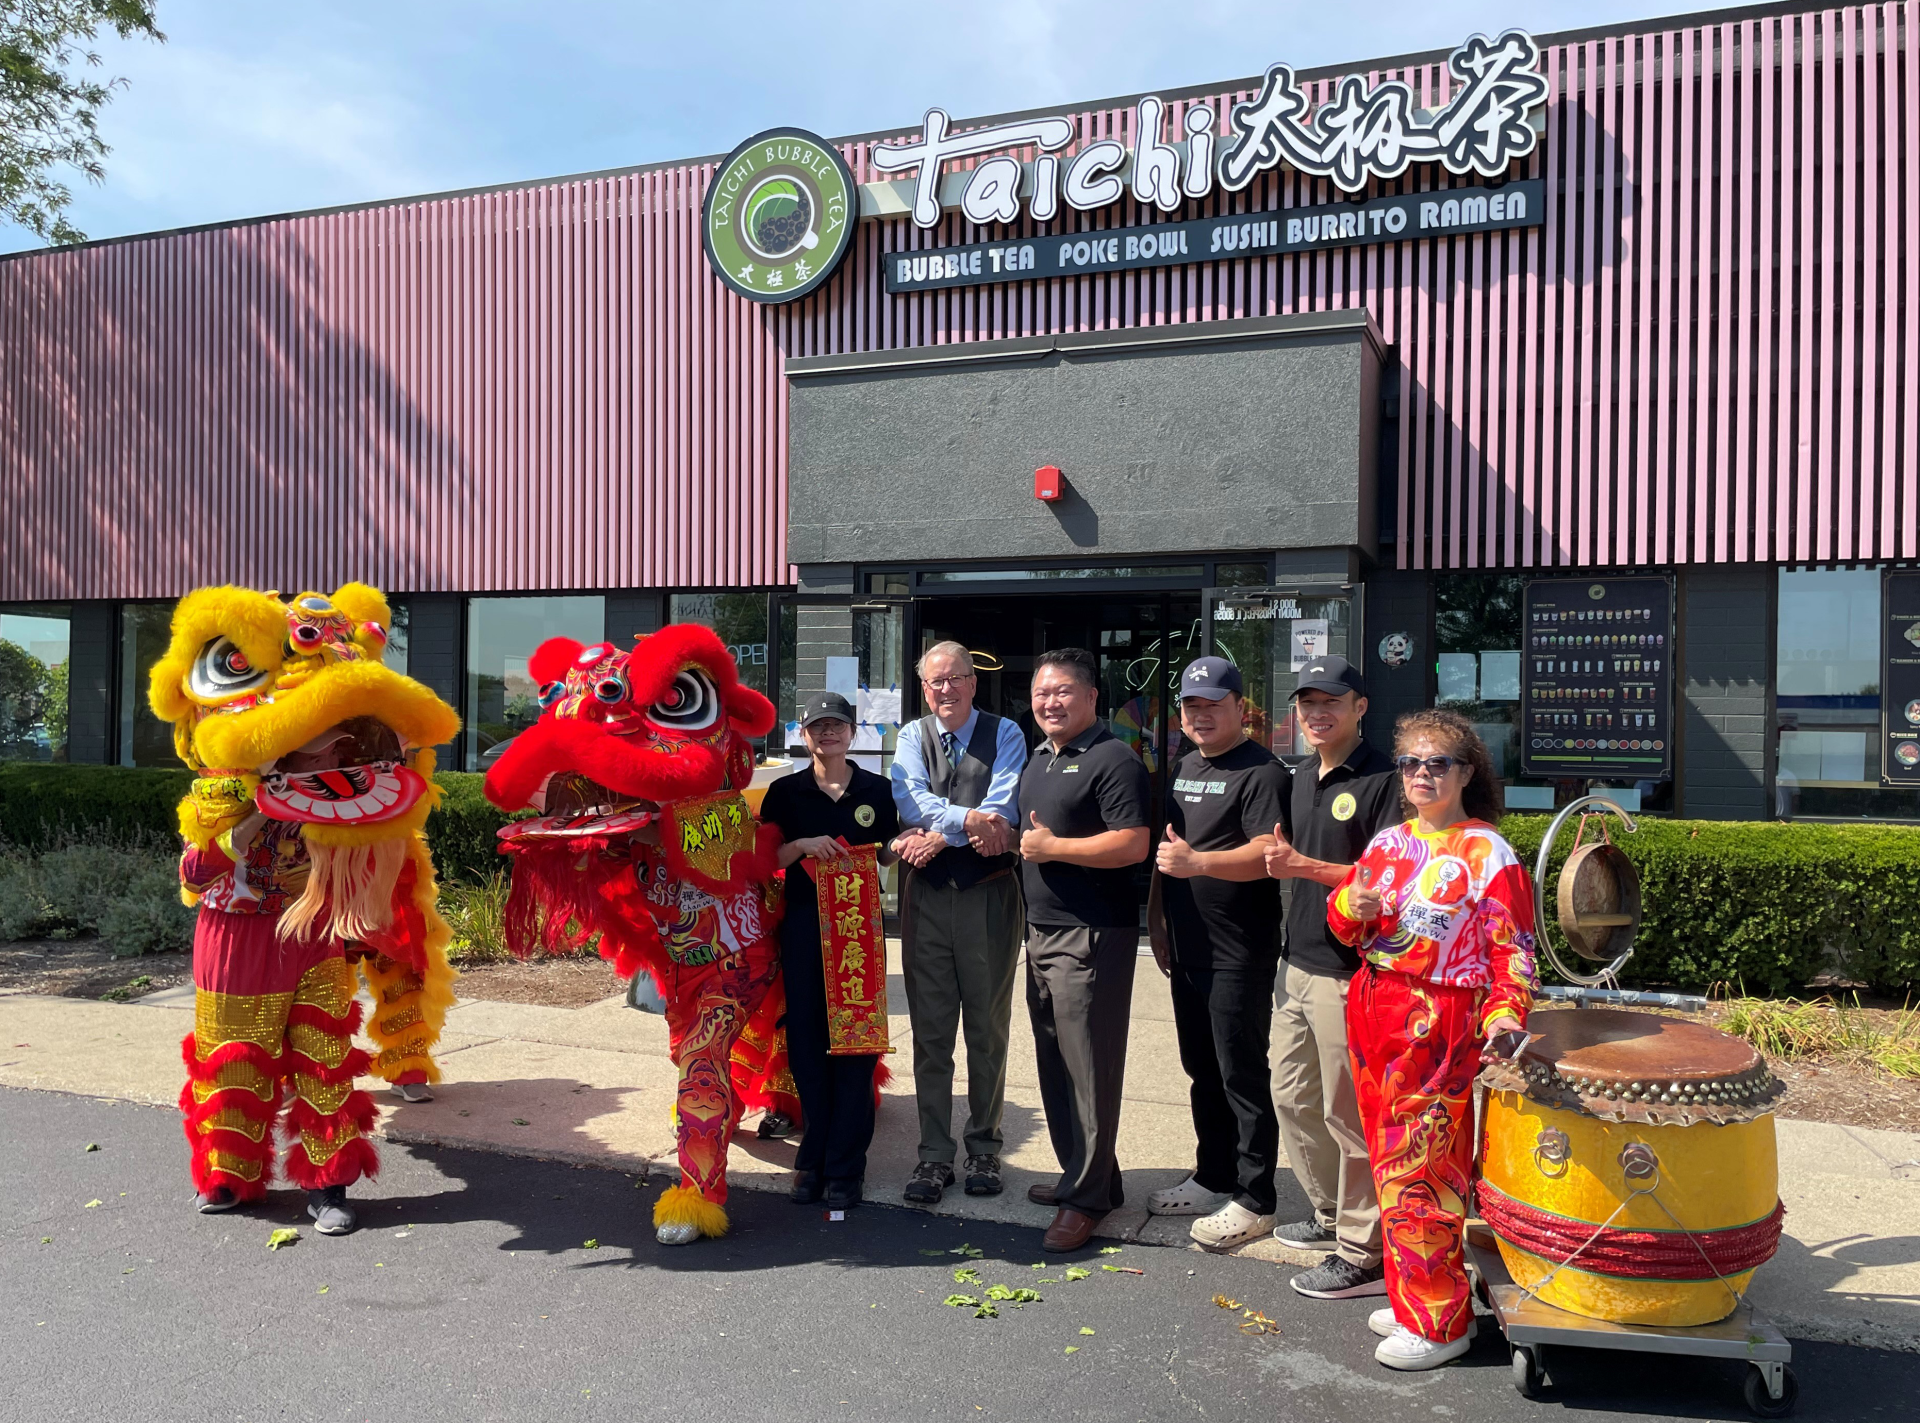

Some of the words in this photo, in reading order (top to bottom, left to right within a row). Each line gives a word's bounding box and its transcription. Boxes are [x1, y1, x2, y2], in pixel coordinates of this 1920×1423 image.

[715, 158, 755, 230] TAICHI
[766, 145, 831, 181] BUBBLE
[826, 191, 844, 234] TEA
[871, 96, 1215, 229] Taichi
[896, 248, 982, 284] BUBBLE
[988, 244, 1035, 273] TEA
[1058, 238, 1119, 266] POKE
[1125, 231, 1188, 261] BOWL
[1210, 220, 1278, 254] SUSHI
[1286, 206, 1407, 245] BURRITO
[1419, 190, 1527, 229] RAMEN
[1295, 629, 1316, 637] POWERED
[1205, 782, 1227, 795] TEA
[833, 872, 874, 1008] 財源廣進
[1404, 920, 1428, 934] Chan
[1430, 930, 1447, 941] Wu
